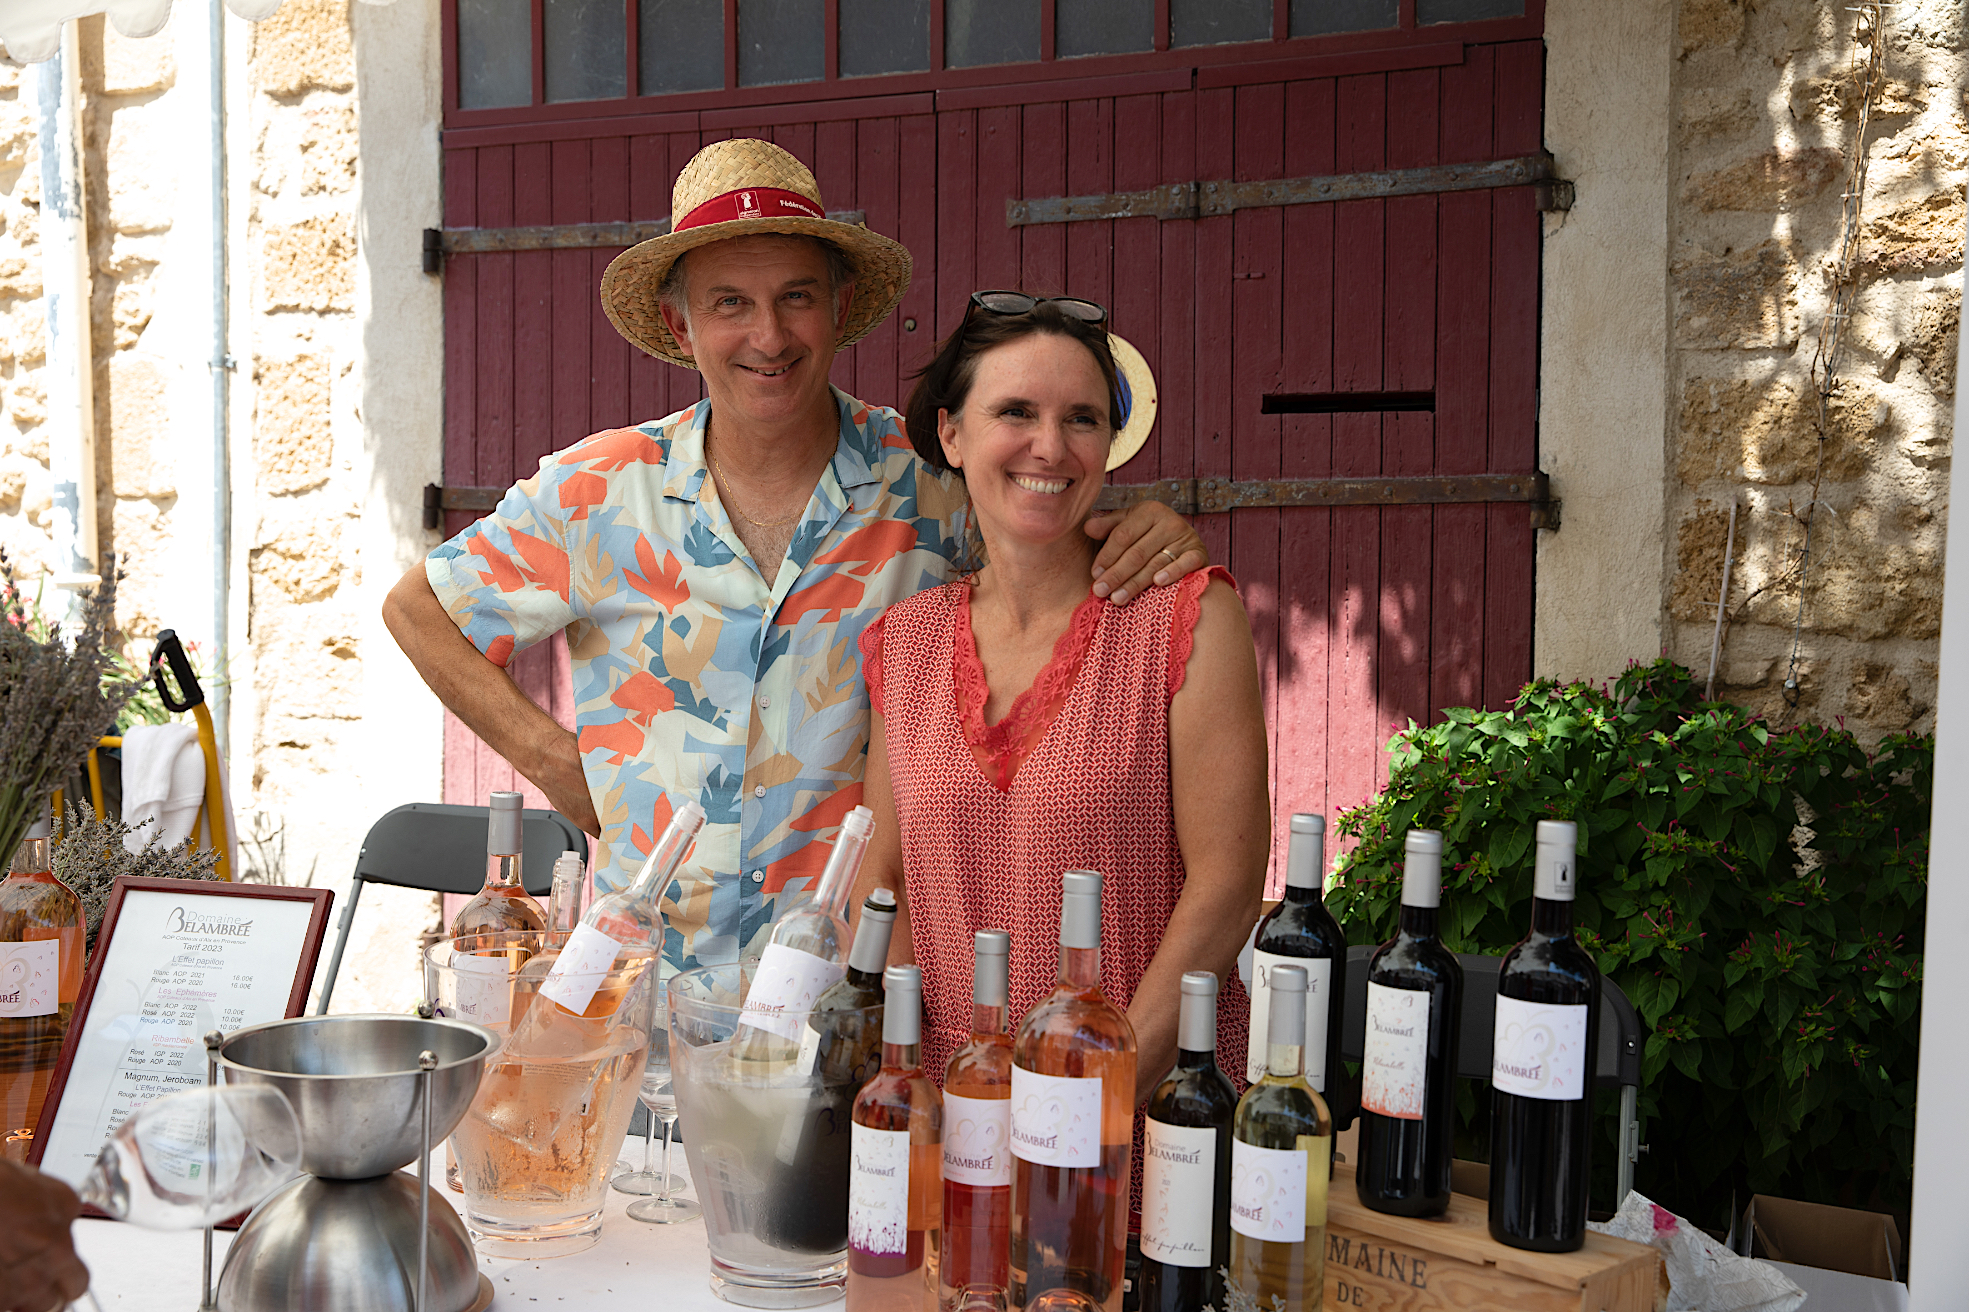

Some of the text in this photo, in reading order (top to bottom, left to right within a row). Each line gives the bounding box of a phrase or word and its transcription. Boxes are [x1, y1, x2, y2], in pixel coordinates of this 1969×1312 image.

[164, 906, 254, 936] BELAMBRÉE
[186, 910, 242, 924] Domaine
[183, 943, 201, 951] Tarif
[172, 955, 224, 966] L'Effet papillon
[152, 1035, 194, 1044] Ribambelle
[124, 1072, 202, 1085] Magnum, Jeroboam
[1147, 1131, 1201, 1164] BELAMBRÉE
[1154, 1138, 1186, 1152] Domaine
[1328, 1233, 1427, 1289] MAINE
[1337, 1281, 1364, 1307] DE
